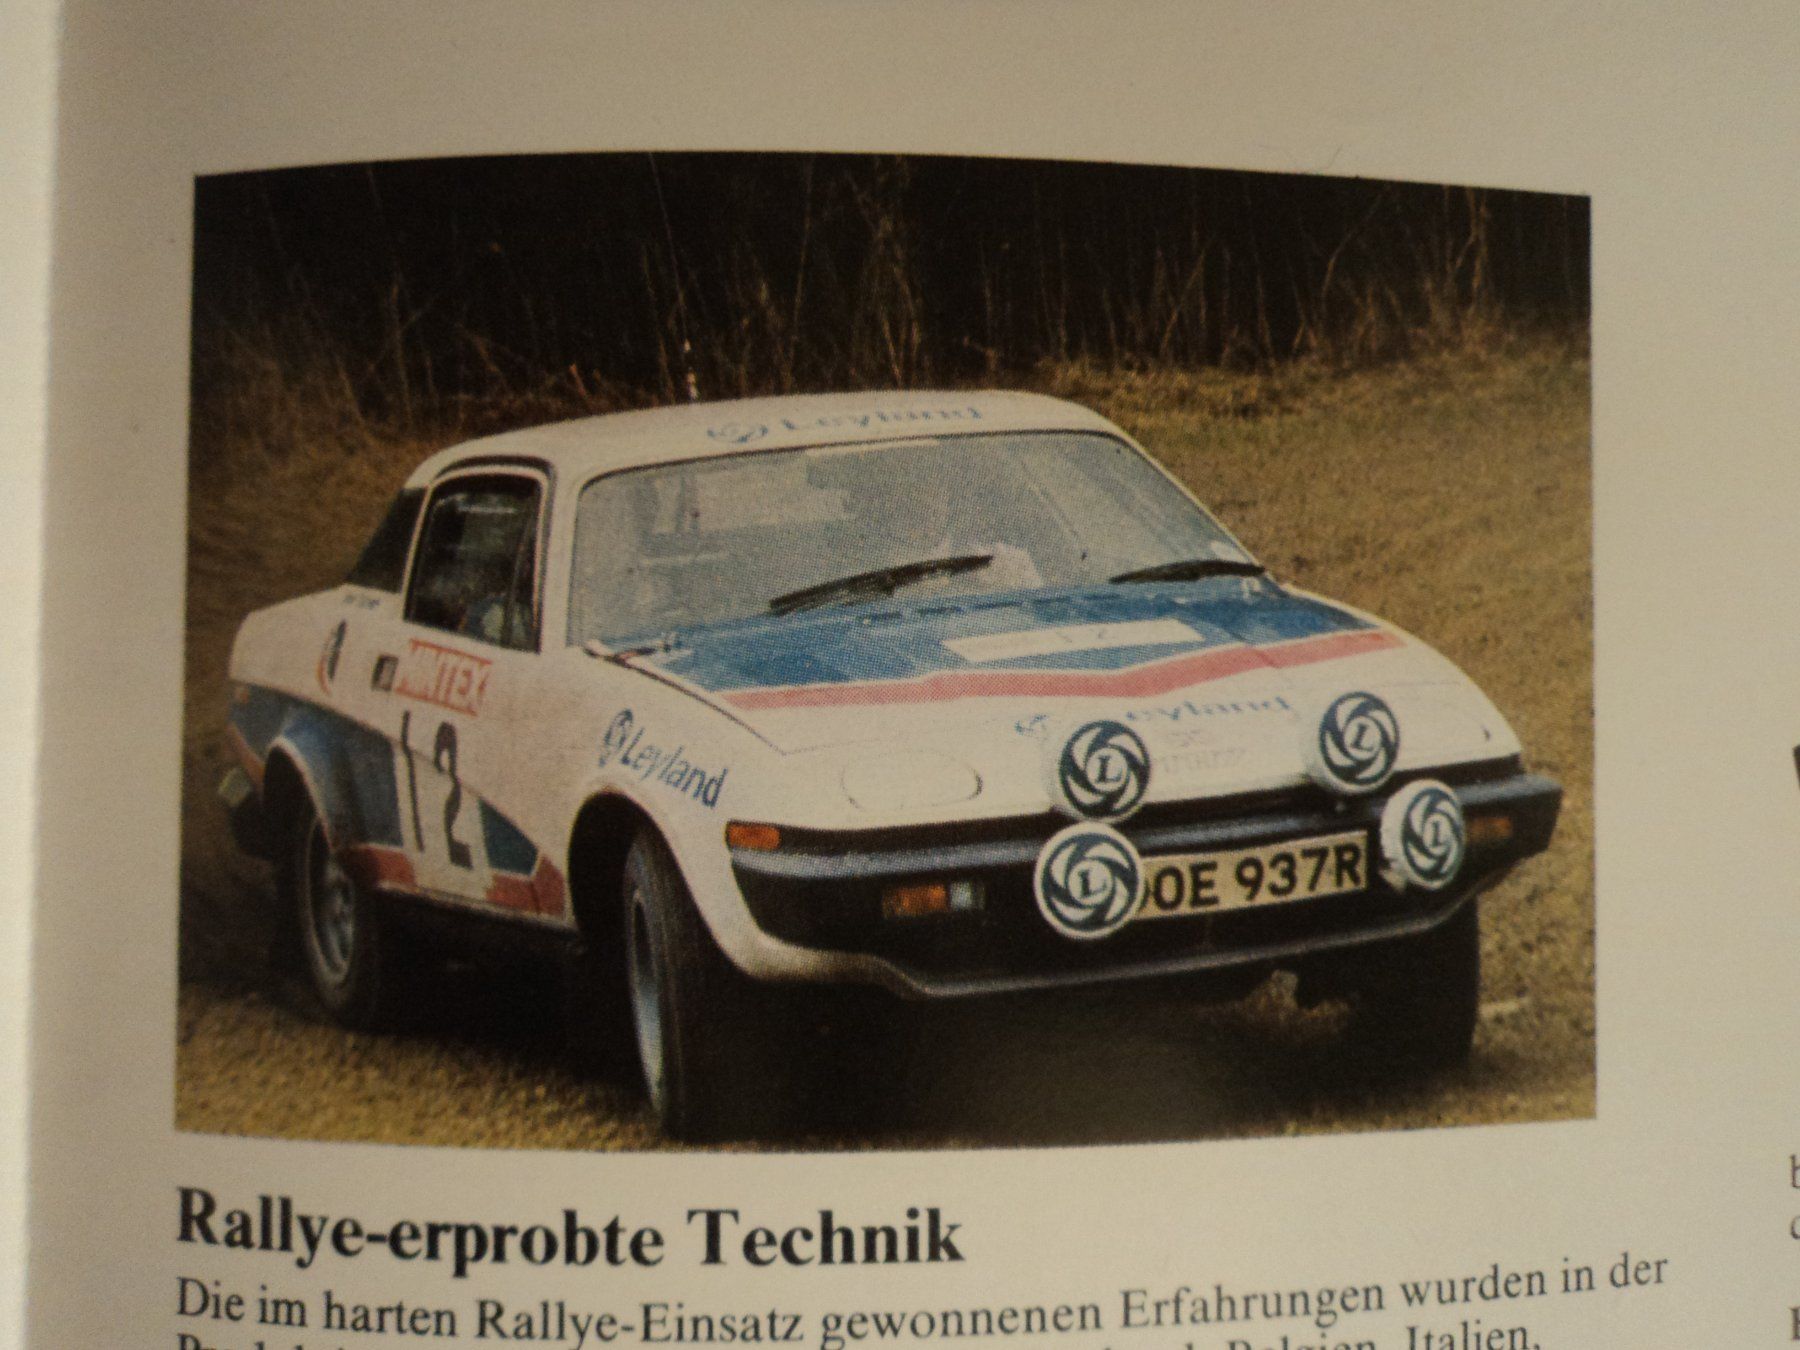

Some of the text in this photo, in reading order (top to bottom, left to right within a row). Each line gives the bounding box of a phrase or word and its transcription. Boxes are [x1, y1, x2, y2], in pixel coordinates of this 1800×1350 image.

[401, 711, 473, 869] 12
[620, 727, 728, 808] Leyland
[1140, 843, 1362, 910] OE 937R
[176, 1187, 965, 1278] Rallye-erprobte Technik
[176, 1251, 1670, 1350] Die im harten Rallye-Einsatz gewonnenen Erfahrungen wurden in der
